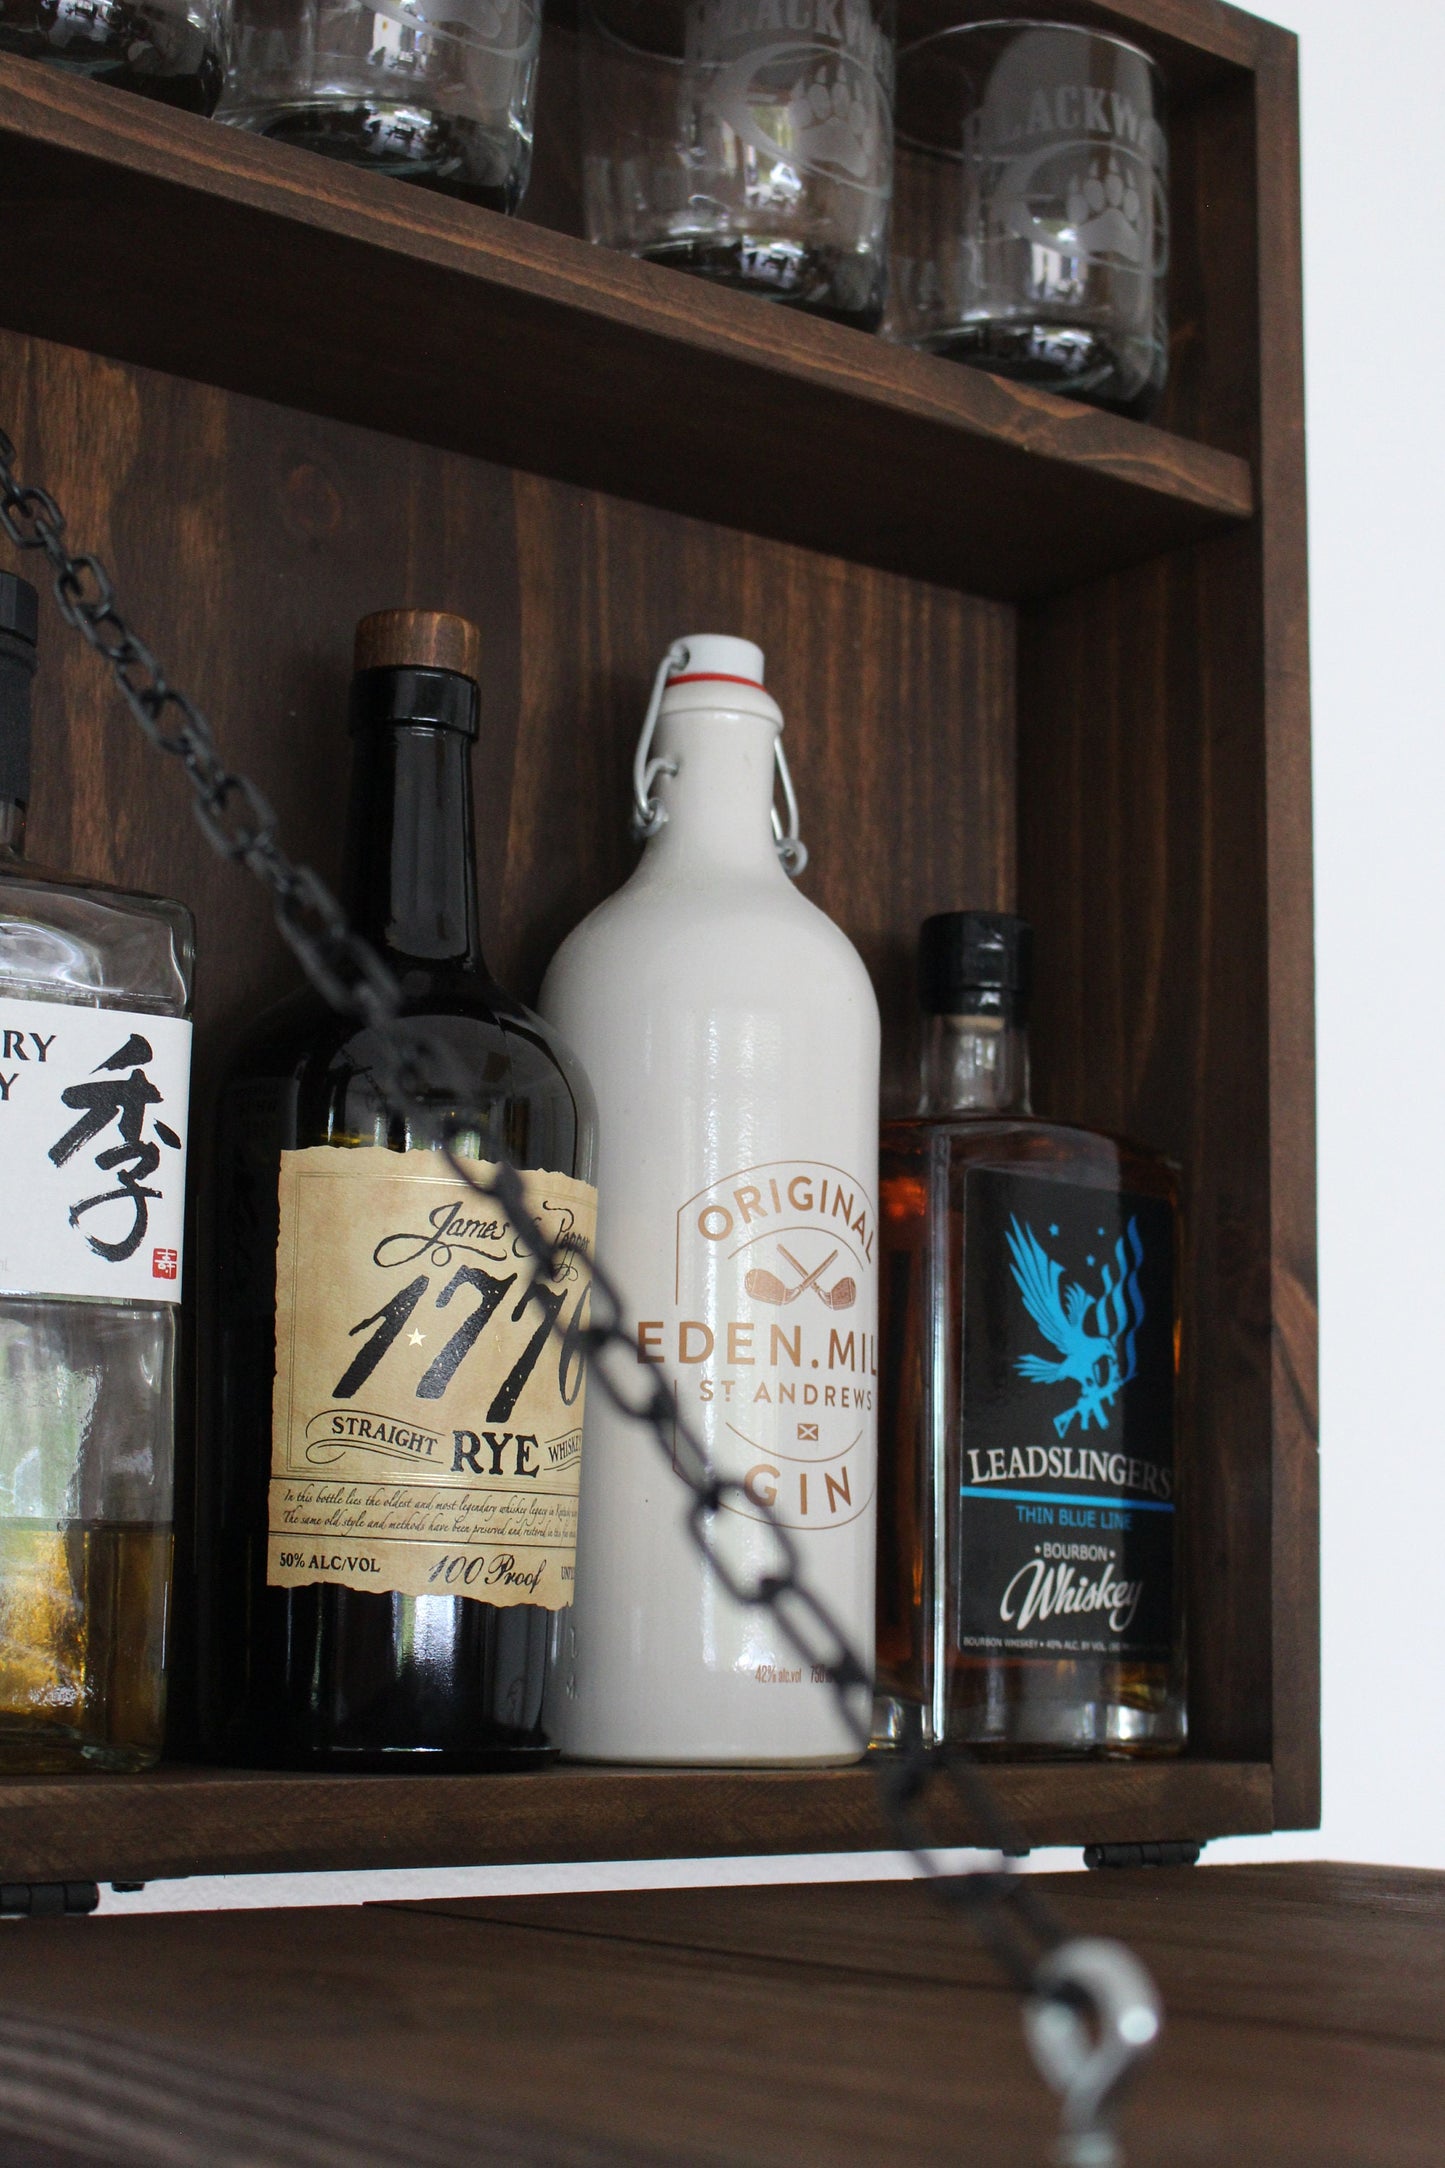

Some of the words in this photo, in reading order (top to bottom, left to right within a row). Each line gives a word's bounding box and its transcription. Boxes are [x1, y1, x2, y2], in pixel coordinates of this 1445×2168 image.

[373, 1200, 508, 1268] James
[697, 1175, 874, 1264] ORIGINAL
[331, 1263, 593, 1425] 1776
[753, 1381, 873, 1411] ANDREWS
[331, 1415, 439, 1457] STRAIGHT
[449, 1429, 541, 1479] RYE
[743, 1463, 852, 1516] GIN
[966, 1445, 1173, 1500] LEADSLINGERS
[283, 1488, 294, 1502] In
[296, 1483, 315, 1503] this
[316, 1485, 346, 1505] bottle
[345, 1487, 362, 1506] lies
[365, 1487, 386, 1507] the
[383, 1490, 414, 1509] oldest
[414, 1491, 441, 1511] and
[435, 1499, 458, 1512] most
[454, 1493, 498, 1524] legendary
[283, 1504, 303, 1525] The
[300, 1515, 322, 1526] same
[324, 1508, 348, 1527] old
[341, 1509, 368, 1537] style
[367, 1511, 394, 1530] and
[388, 1511, 430, 1532] methods
[428, 1512, 450, 1533] have
[452, 1519, 470, 1534] been
[464, 1517, 513, 1545] preserved
[507, 1518, 527, 1537] and
[1015, 1504, 1054, 1526] THIN
[1058, 1507, 1096, 1529] BLUE
[1100, 1510, 1134, 1532] LINE
[279, 1551, 305, 1569] 50%
[308, 1554, 381, 1573] ALC/VOL
[427, 1553, 484, 1585] 100
[483, 1552, 547, 1594] Proof
[1042, 1541, 1108, 1562] BOURBON
[999, 1558, 1144, 1633] Whiskey
[755, 1664, 777, 1684] 42%
